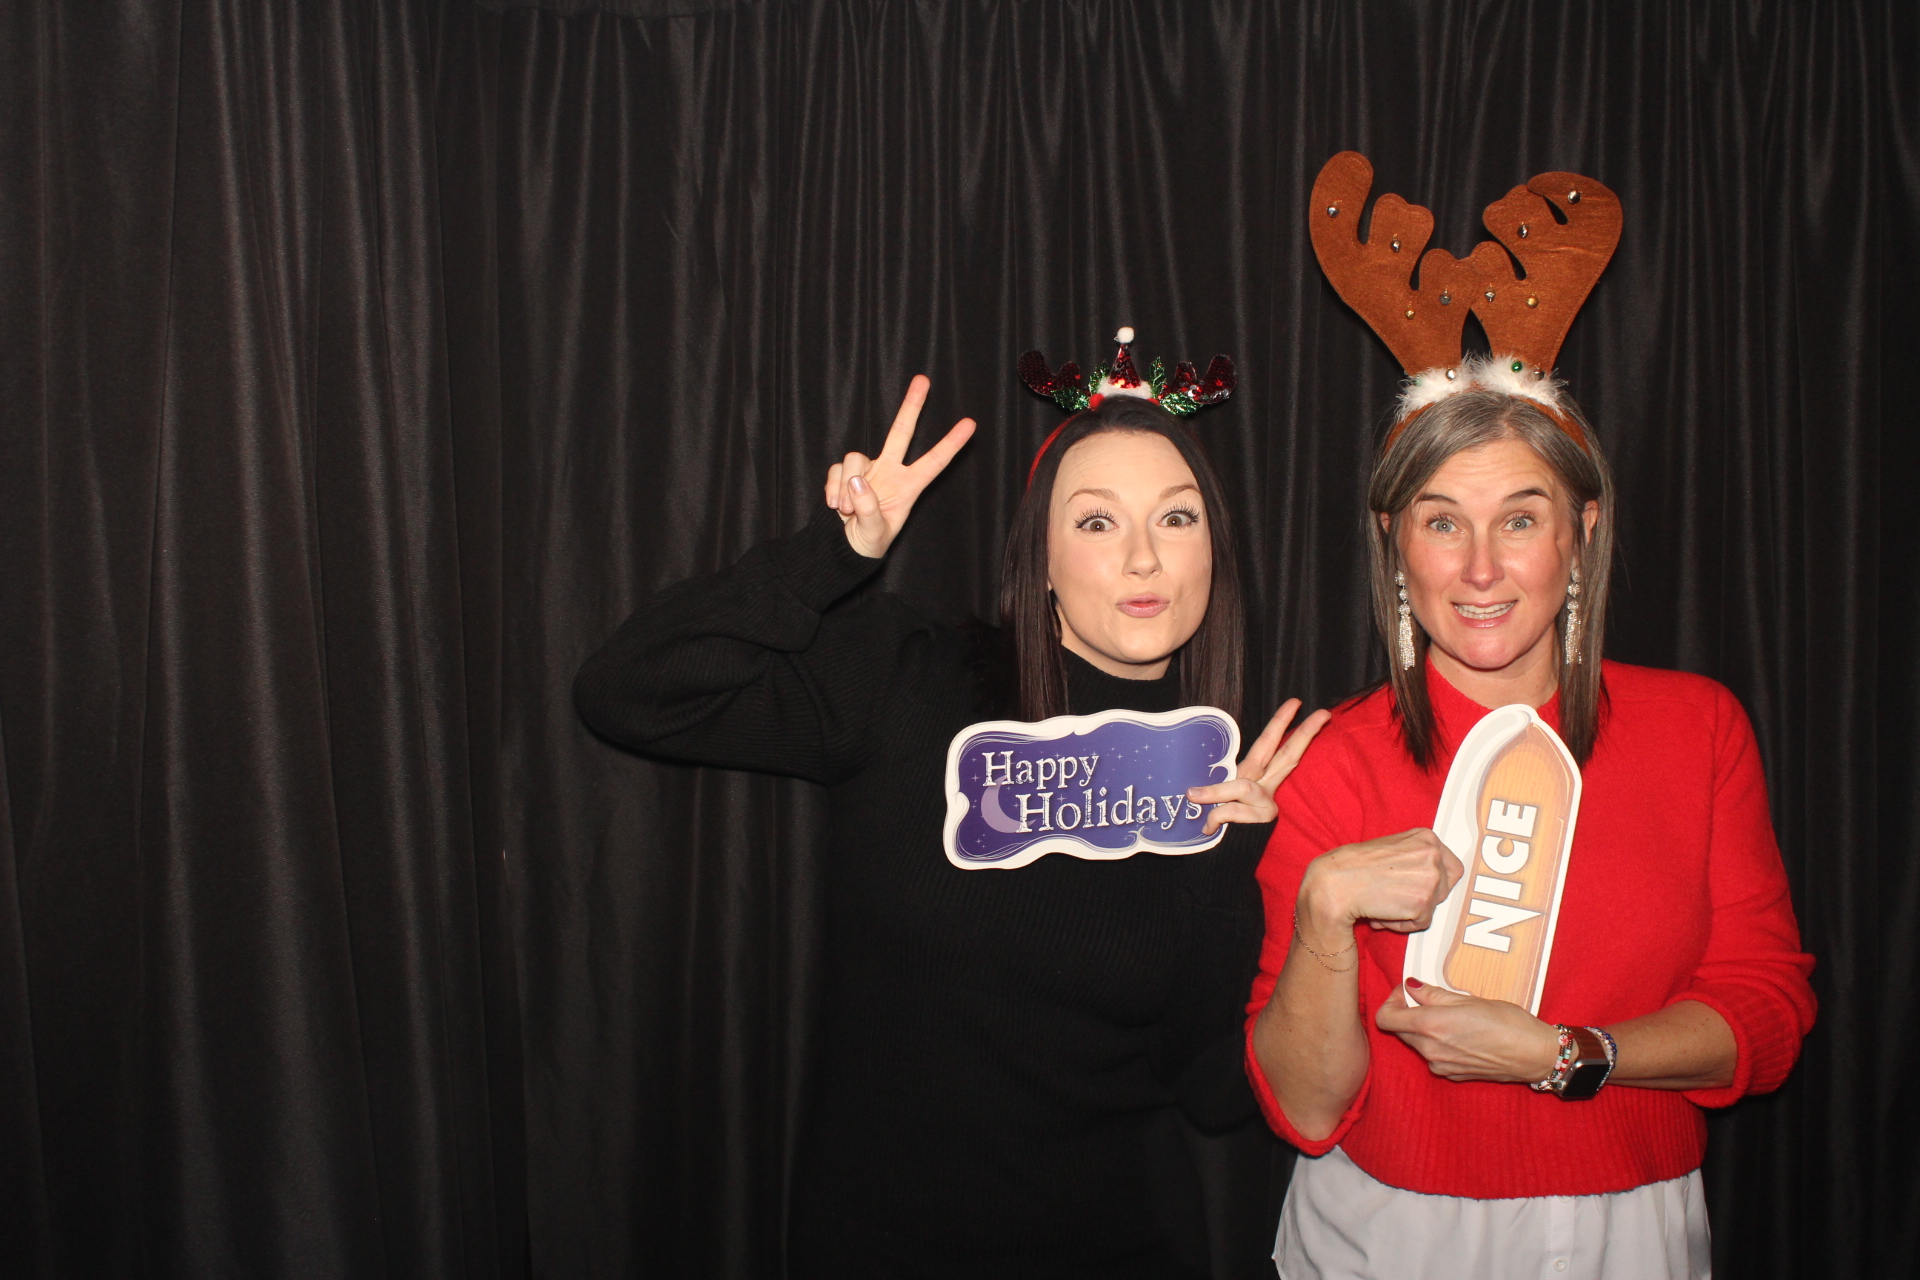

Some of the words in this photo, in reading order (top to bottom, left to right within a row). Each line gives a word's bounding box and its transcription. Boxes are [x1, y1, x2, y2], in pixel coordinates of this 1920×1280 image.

[982, 750, 1099, 790] Happy
[1015, 785, 1202, 833] Holidays
[1462, 799, 1545, 953] NICE
